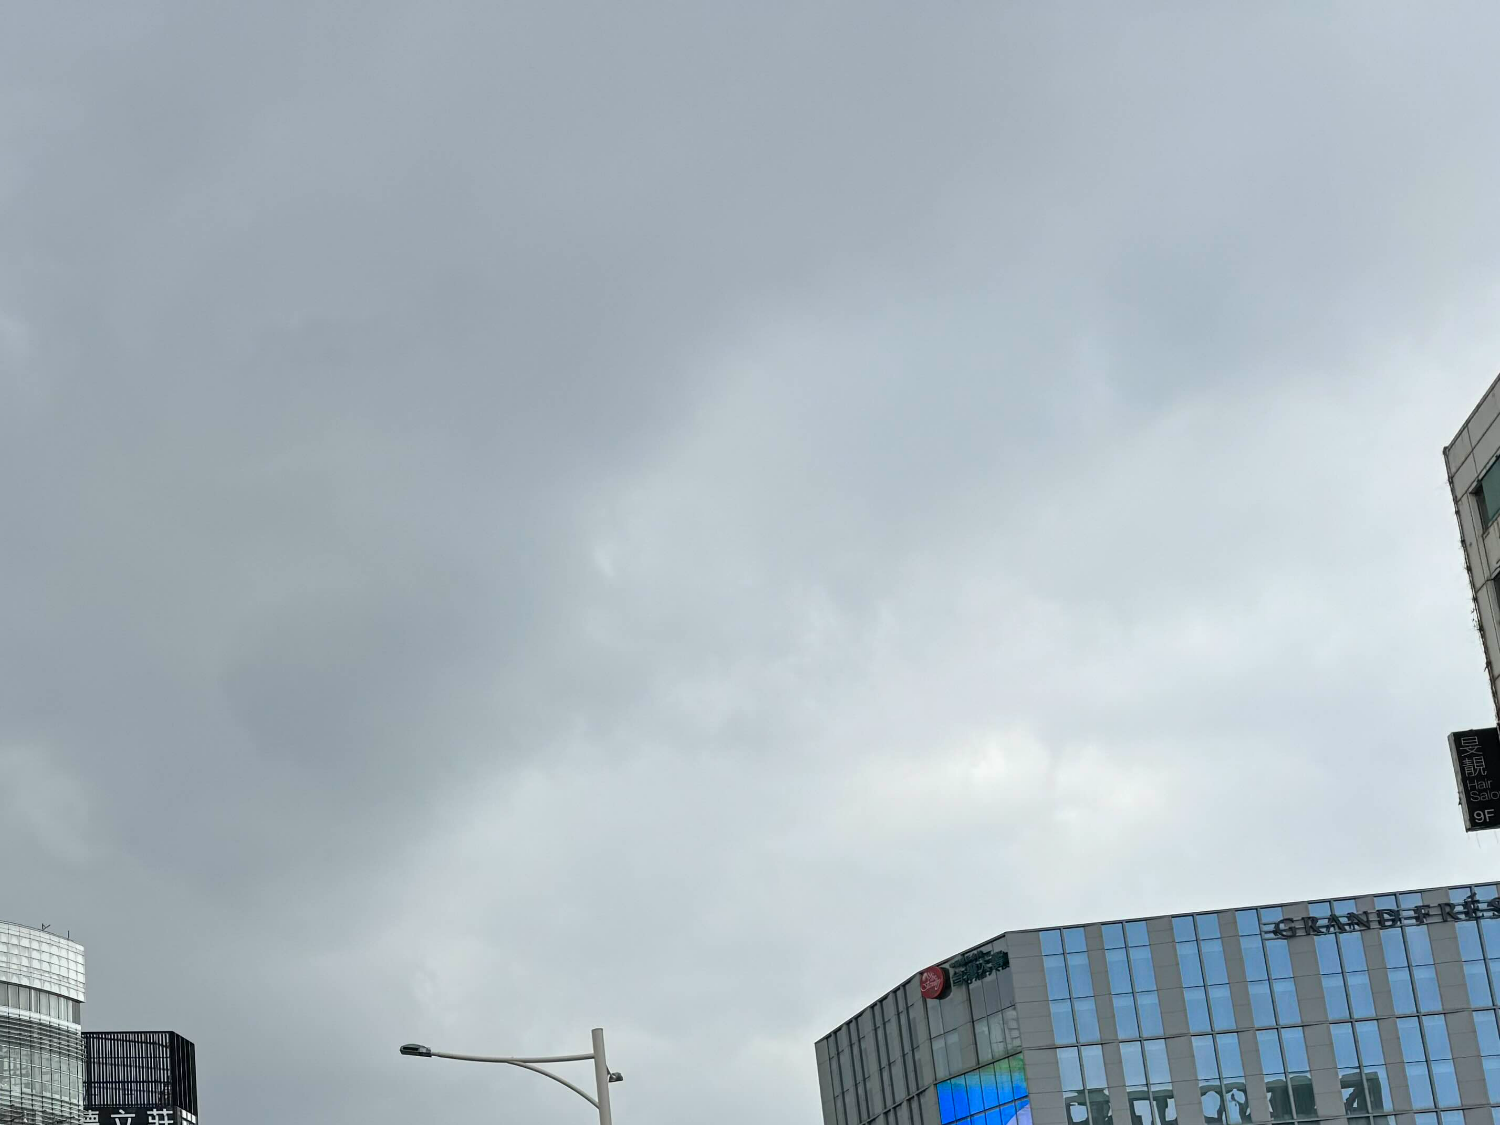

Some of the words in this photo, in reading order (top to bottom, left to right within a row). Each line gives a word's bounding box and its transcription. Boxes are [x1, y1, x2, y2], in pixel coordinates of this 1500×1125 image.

[1467, 779, 1493, 791] Hair
[1470, 790, 1500, 802] Salo
[1474, 808, 1495, 823] 9F
[1273, 907, 1401, 938] GRAND
